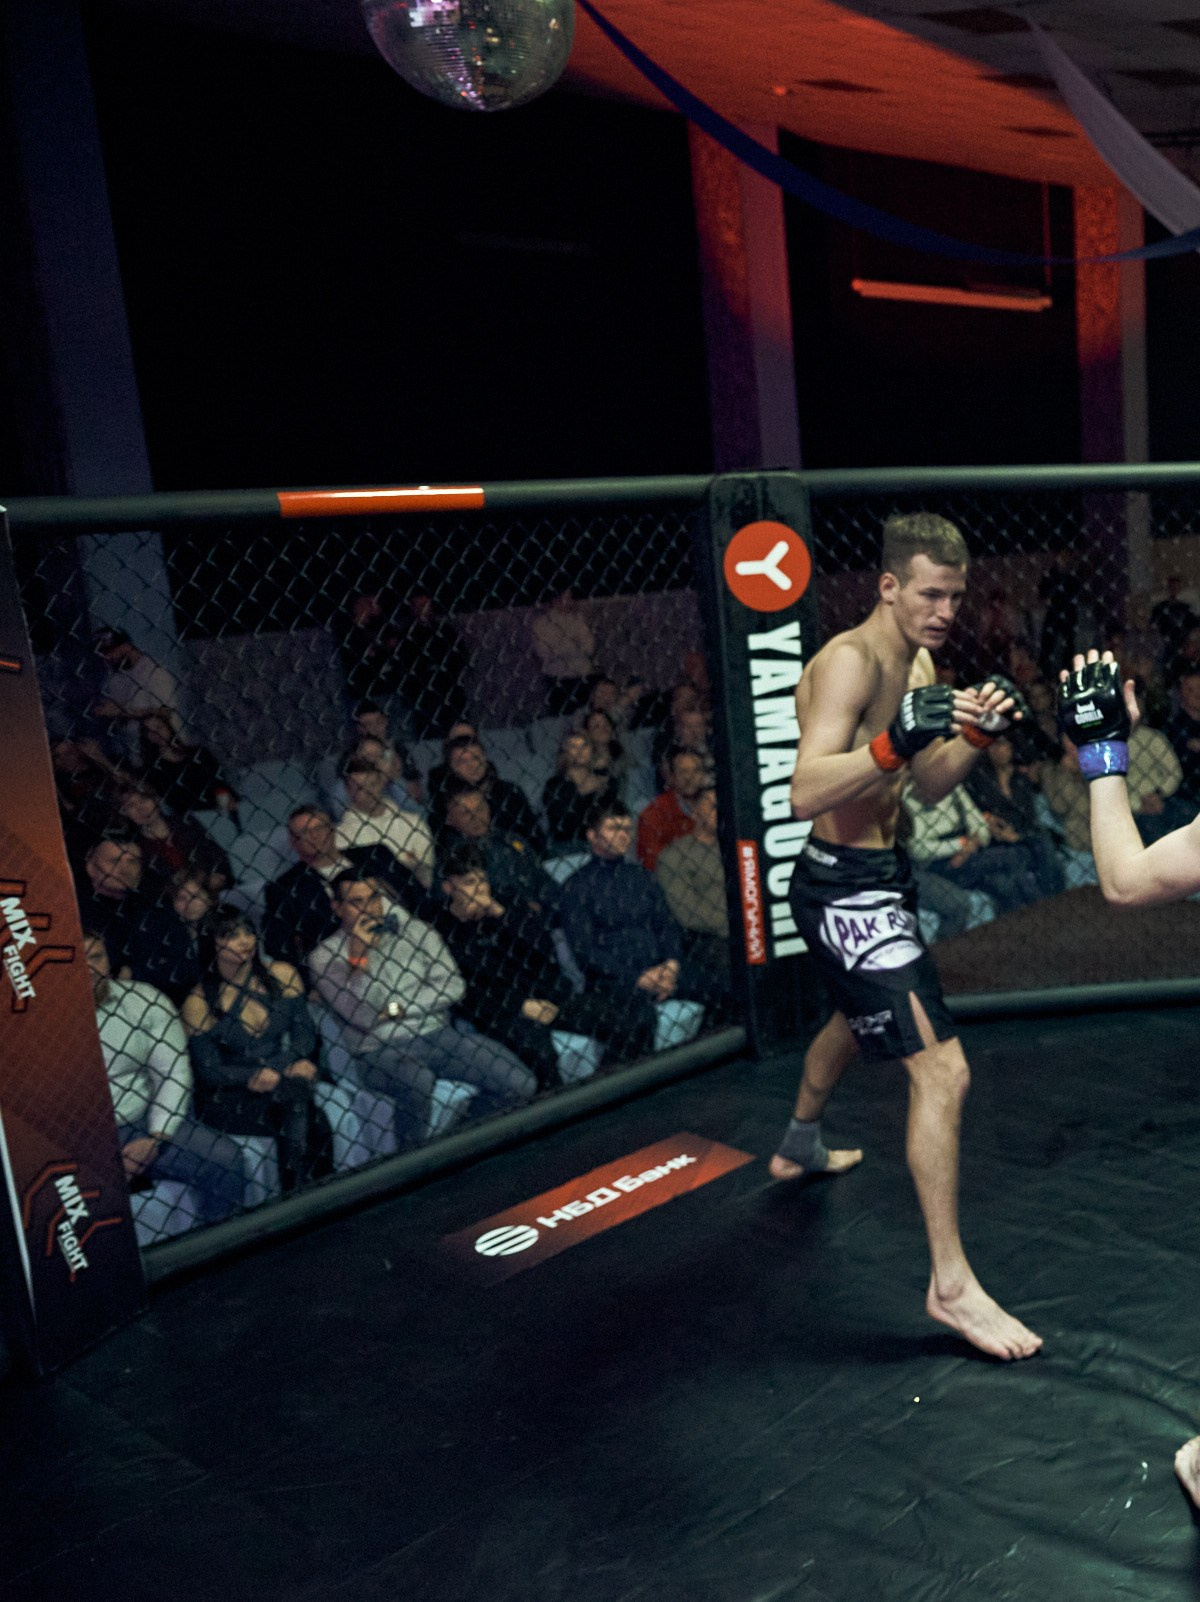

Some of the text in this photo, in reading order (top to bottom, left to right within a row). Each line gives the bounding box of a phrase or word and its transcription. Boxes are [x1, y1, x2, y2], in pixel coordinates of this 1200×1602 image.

[1, 897, 36, 950] MIX
[3, 943, 36, 1000] FIGHT
[54, 1175, 90, 1224] MIX
[537, 1187, 621, 1228] НБД
[57, 1221, 90, 1272] FIGHT
